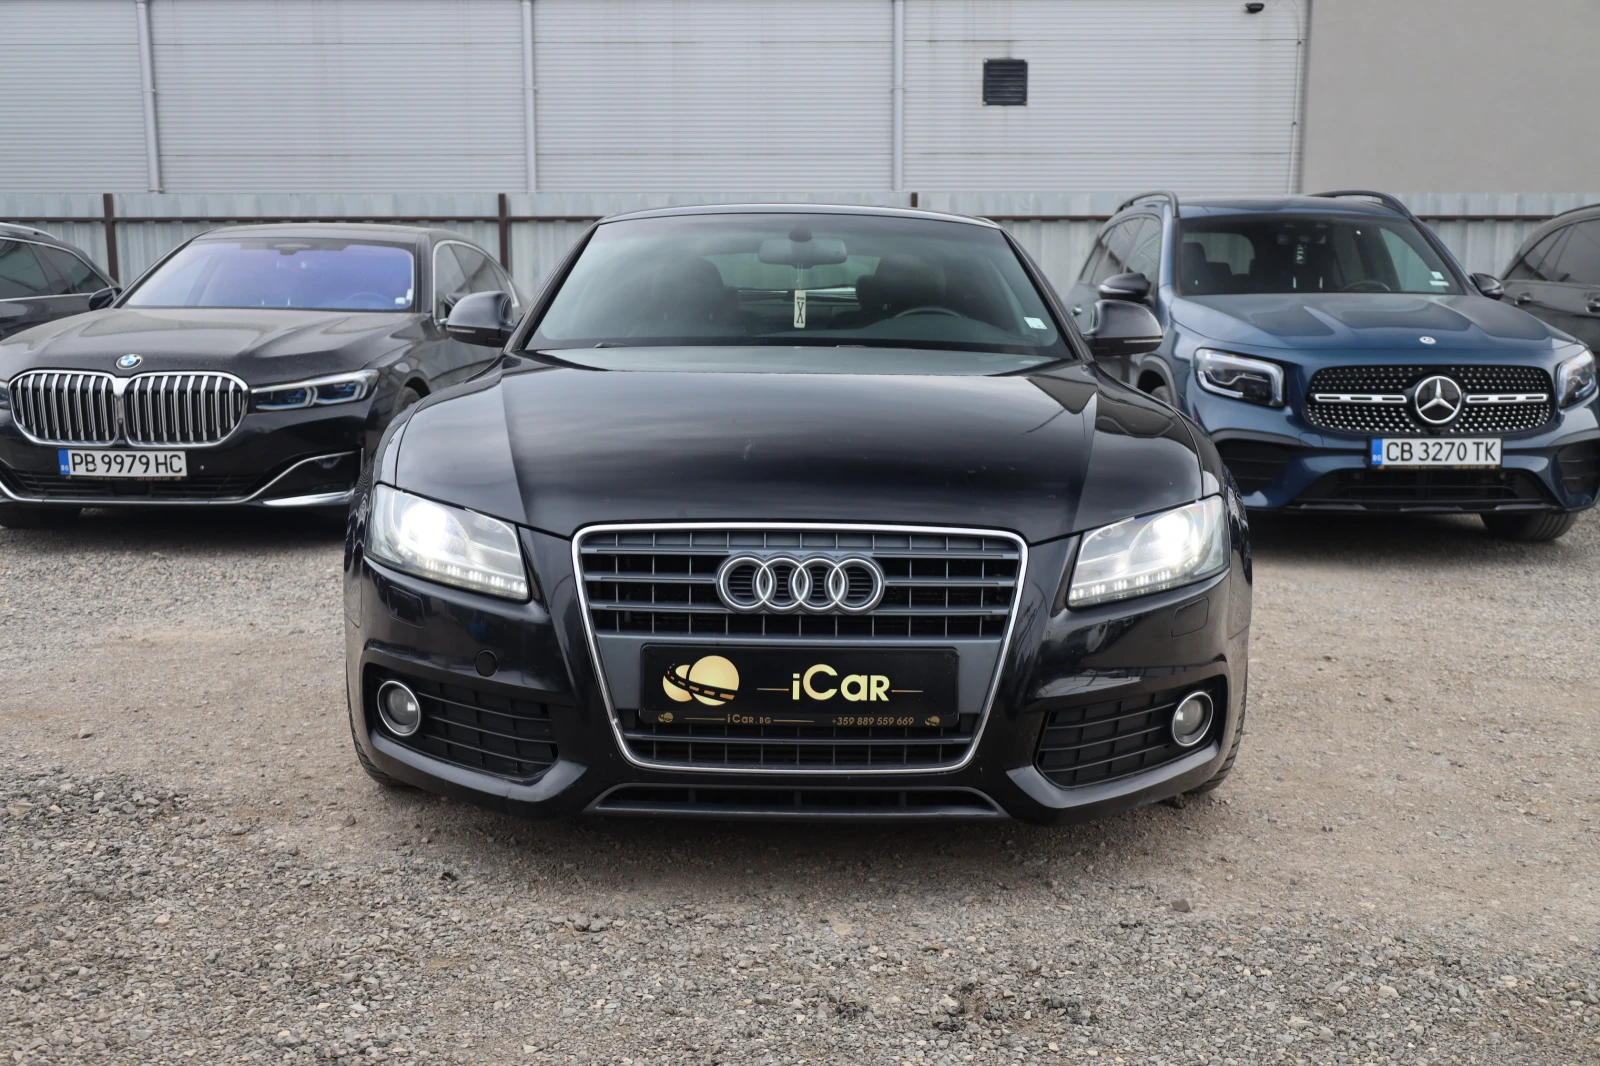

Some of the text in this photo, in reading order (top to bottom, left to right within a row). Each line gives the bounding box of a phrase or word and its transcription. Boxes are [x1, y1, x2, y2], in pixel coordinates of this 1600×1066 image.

[1386, 442, 1496, 461] CB 3270 TK
[71, 452, 183, 473] PB 9979 HC
[832, 717, 914, 726] +359 889 559 669
